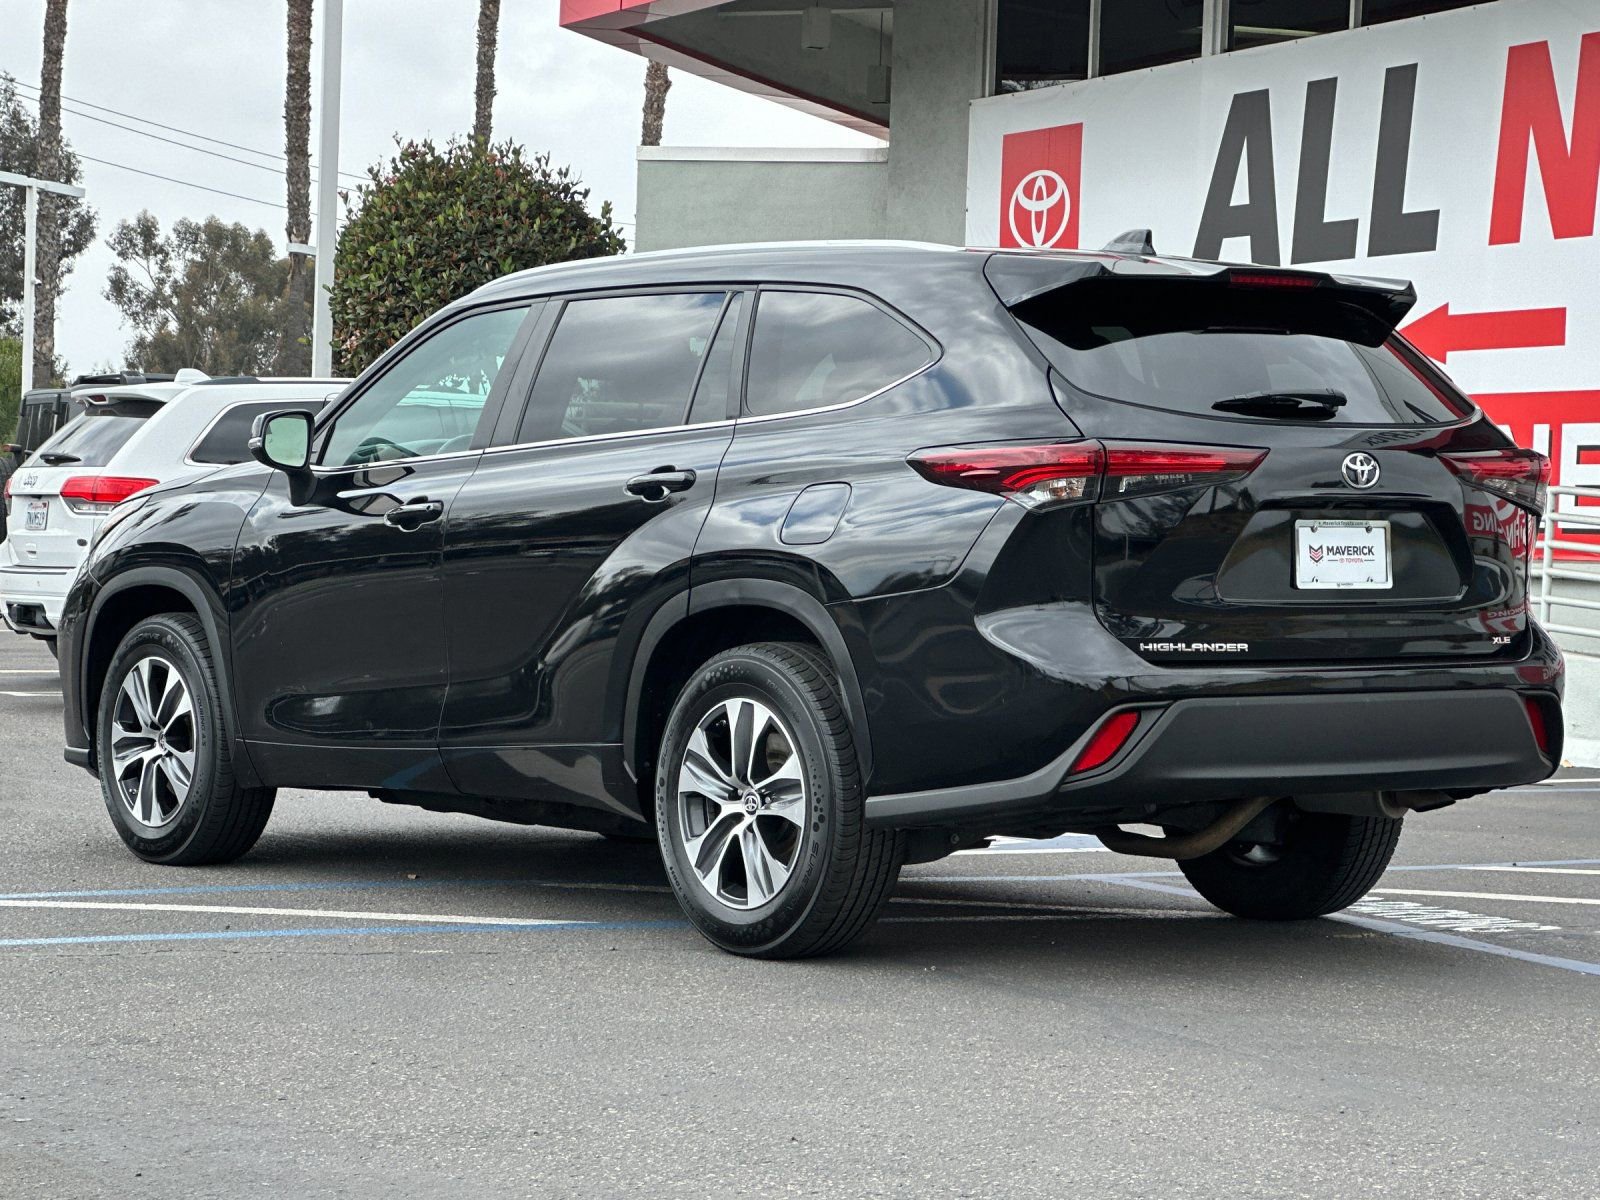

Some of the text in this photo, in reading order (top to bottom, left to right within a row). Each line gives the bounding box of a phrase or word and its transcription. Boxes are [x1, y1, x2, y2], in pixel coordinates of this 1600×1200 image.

[1193, 32, 1600, 267] ALL N
[1326, 546, 1375, 556] MAVERICK
[1492, 636, 1512, 645] XLE
[1139, 642, 1249, 652] HIGHLANDER
